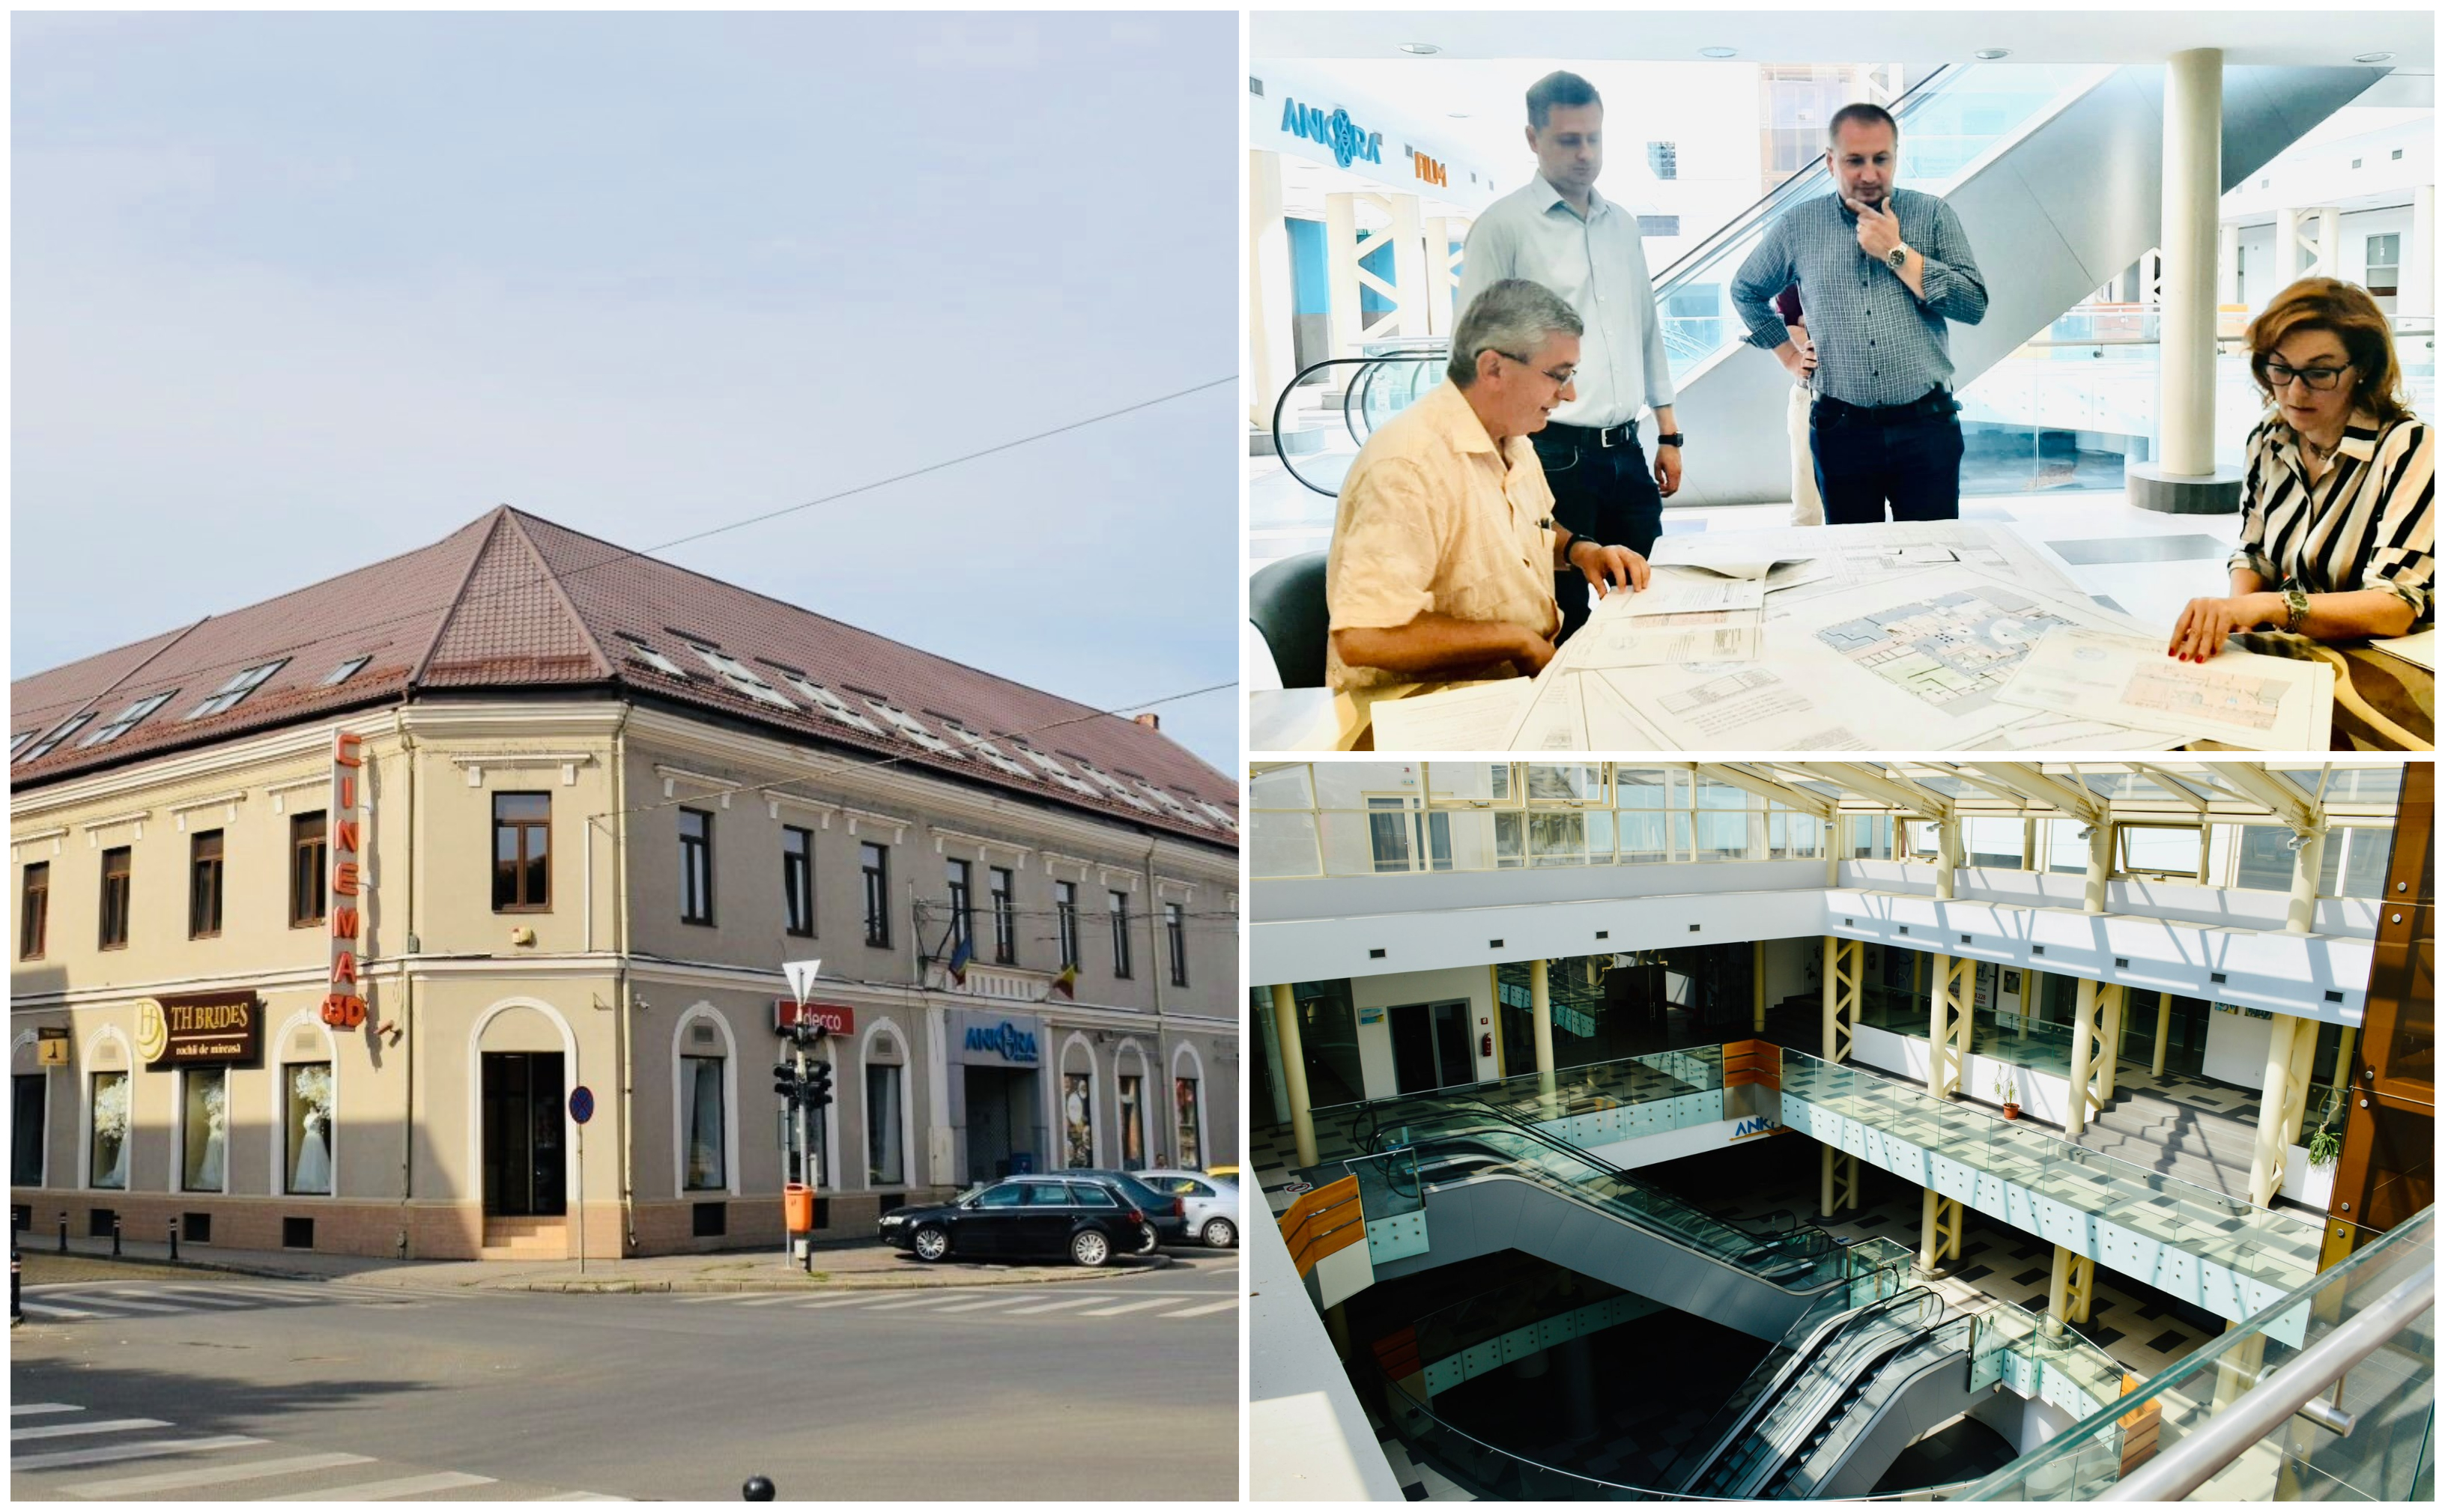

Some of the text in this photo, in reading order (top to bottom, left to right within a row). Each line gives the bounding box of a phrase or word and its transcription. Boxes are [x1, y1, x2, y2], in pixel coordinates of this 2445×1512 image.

[1414, 151, 1447, 187] FILM
[333, 733, 362, 983] CINEMA
[171, 1002, 248, 1030] TH BRIDES
[793, 1007, 841, 1031] decco
[199, 1044, 209, 1054] de
